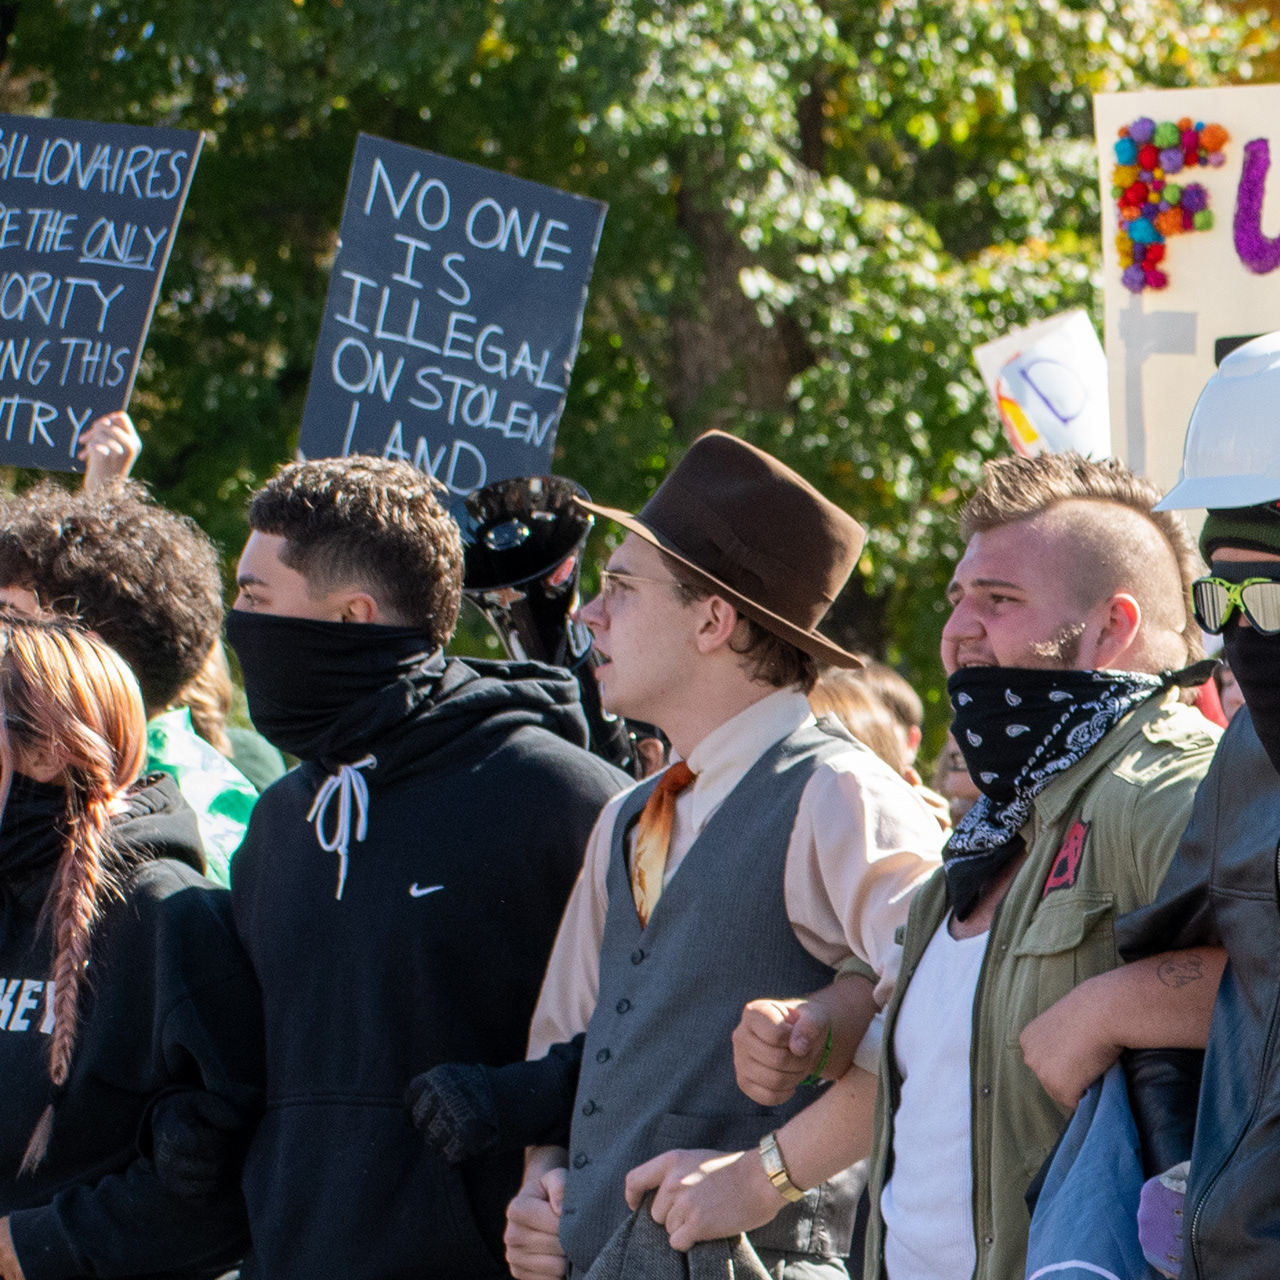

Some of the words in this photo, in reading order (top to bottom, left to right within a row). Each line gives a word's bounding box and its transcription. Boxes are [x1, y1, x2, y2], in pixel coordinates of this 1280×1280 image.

[27, 209, 78, 253] THE
[81, 217, 168, 270] ONLY
[364, 157, 450, 231] NO
[466, 198, 572, 270] ONE
[0, 272, 125, 333] ORITY
[392, 233, 471, 306] IS
[60, 337, 131, 387] THIS
[334, 270, 565, 393] ILLEGAL
[332, 337, 405, 402] ON
[409, 366, 556, 447] STOLEN
